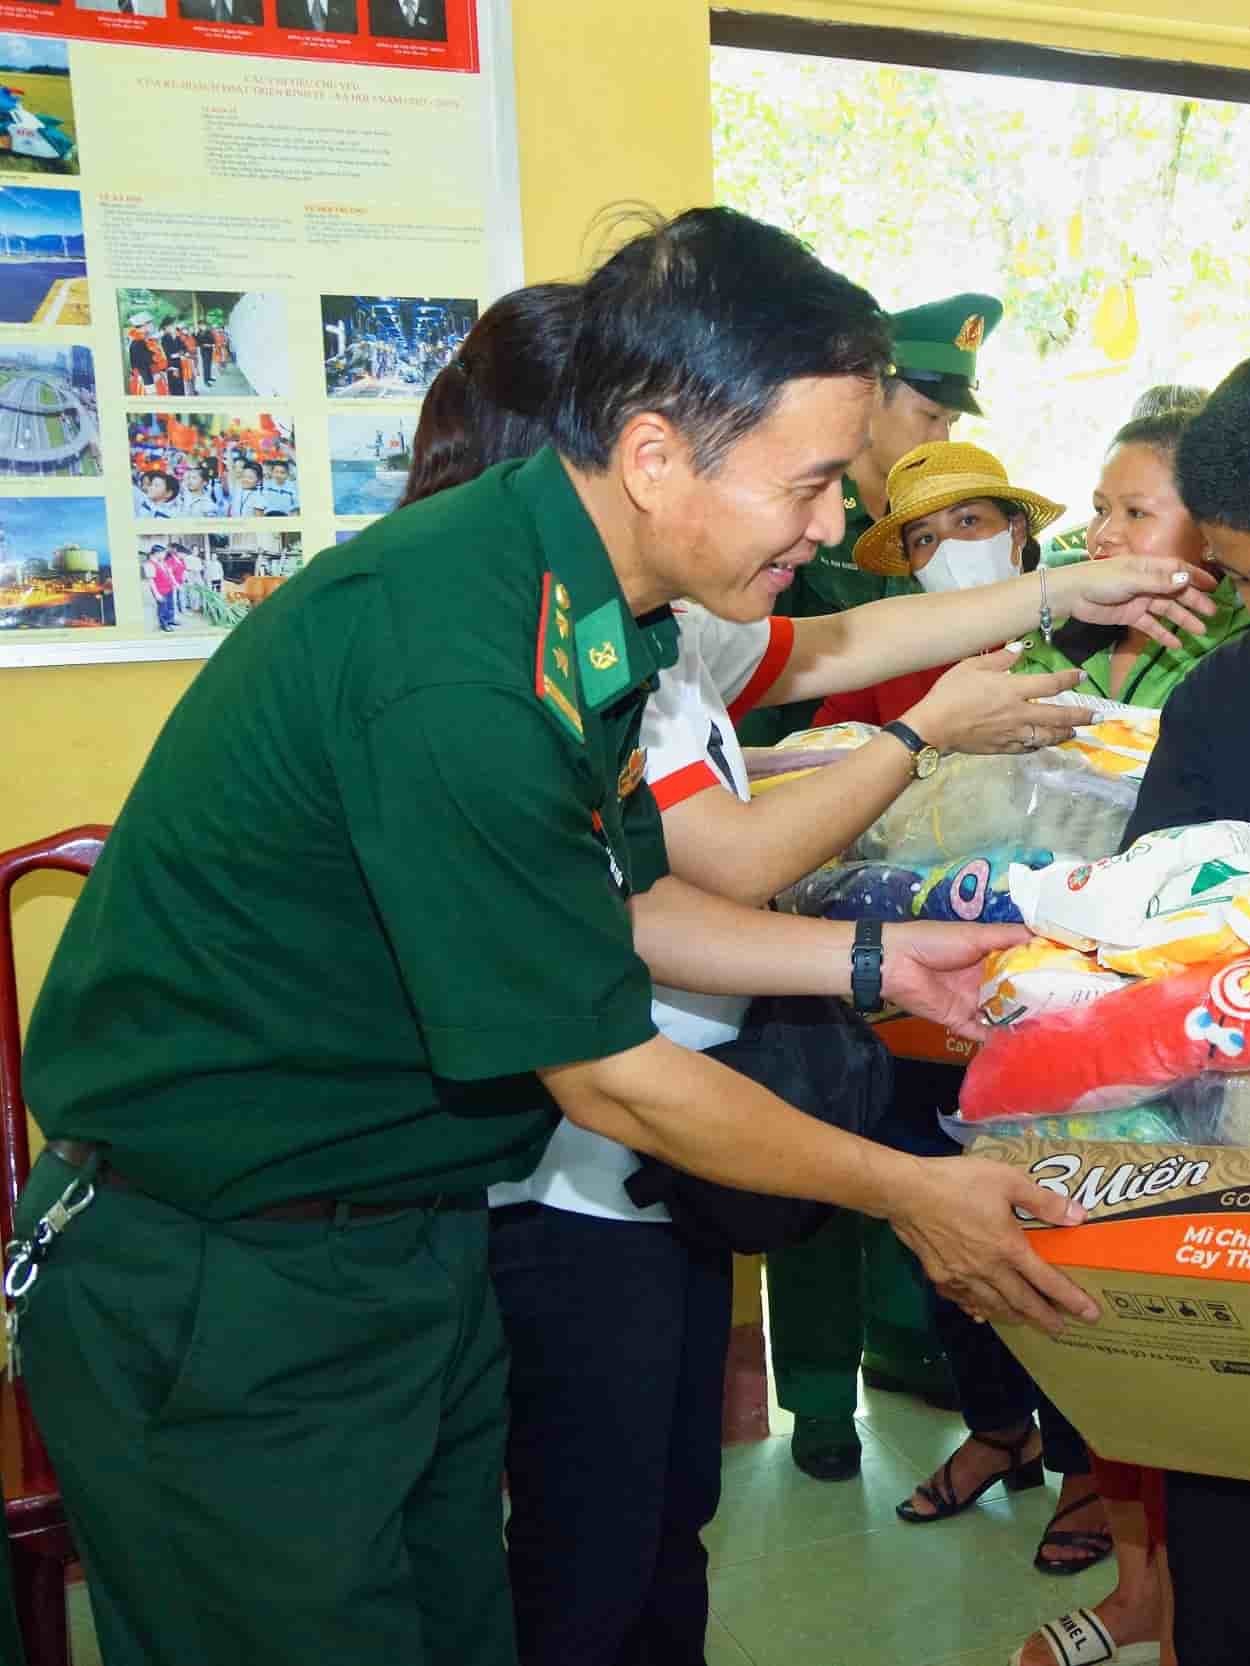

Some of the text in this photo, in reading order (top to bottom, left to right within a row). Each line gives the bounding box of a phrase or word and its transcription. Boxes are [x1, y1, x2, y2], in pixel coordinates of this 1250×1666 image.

[946, 1038, 973, 1056] Cay
[1183, 1226, 1215, 1245] Mì
[1175, 1246, 1220, 1269] Cay
